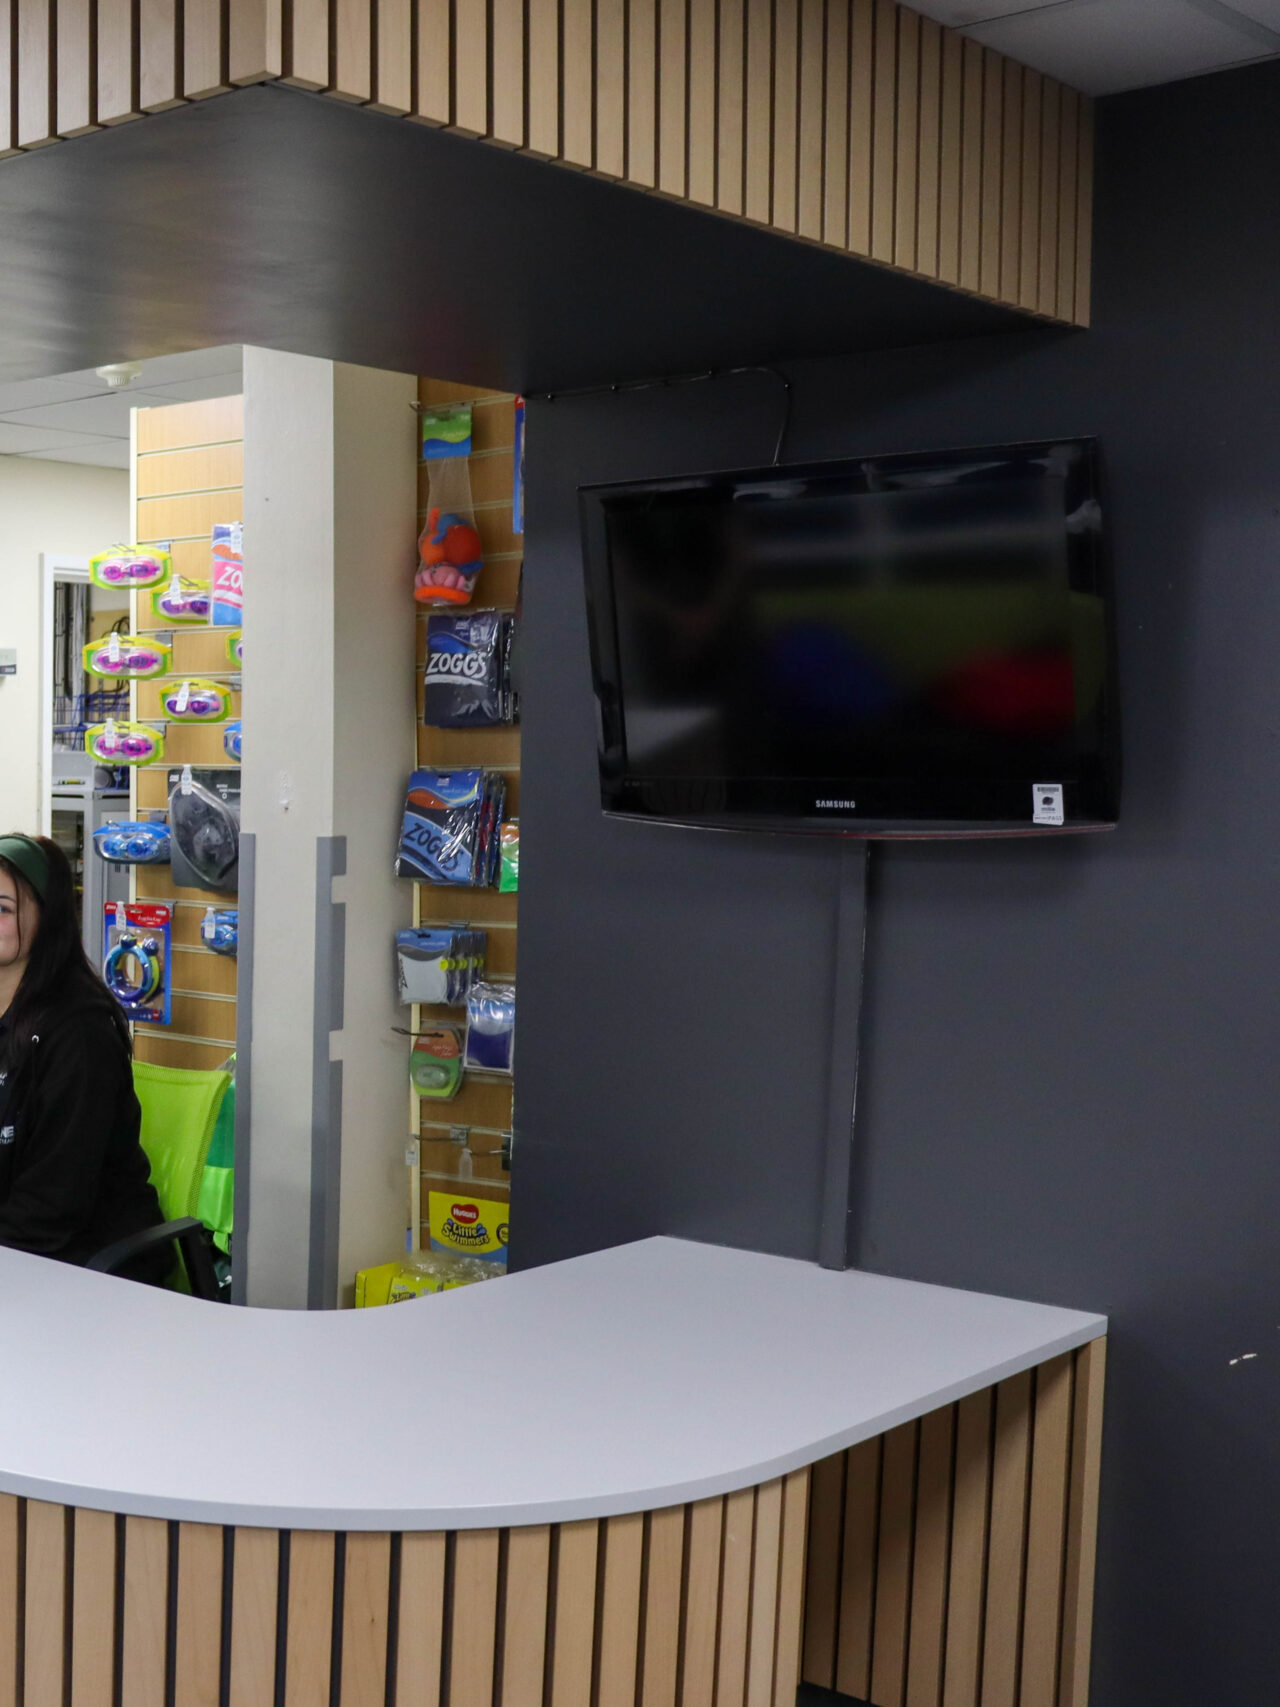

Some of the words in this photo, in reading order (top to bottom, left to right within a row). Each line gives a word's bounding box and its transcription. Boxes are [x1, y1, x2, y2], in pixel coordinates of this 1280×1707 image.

[216, 565, 243, 590] ZO
[426, 651, 488, 679] ZOGGS
[815, 799, 856, 809] SAMSUNG
[442, 1224, 490, 1246] Swimmers
[452, 1223, 478, 1237] Little
